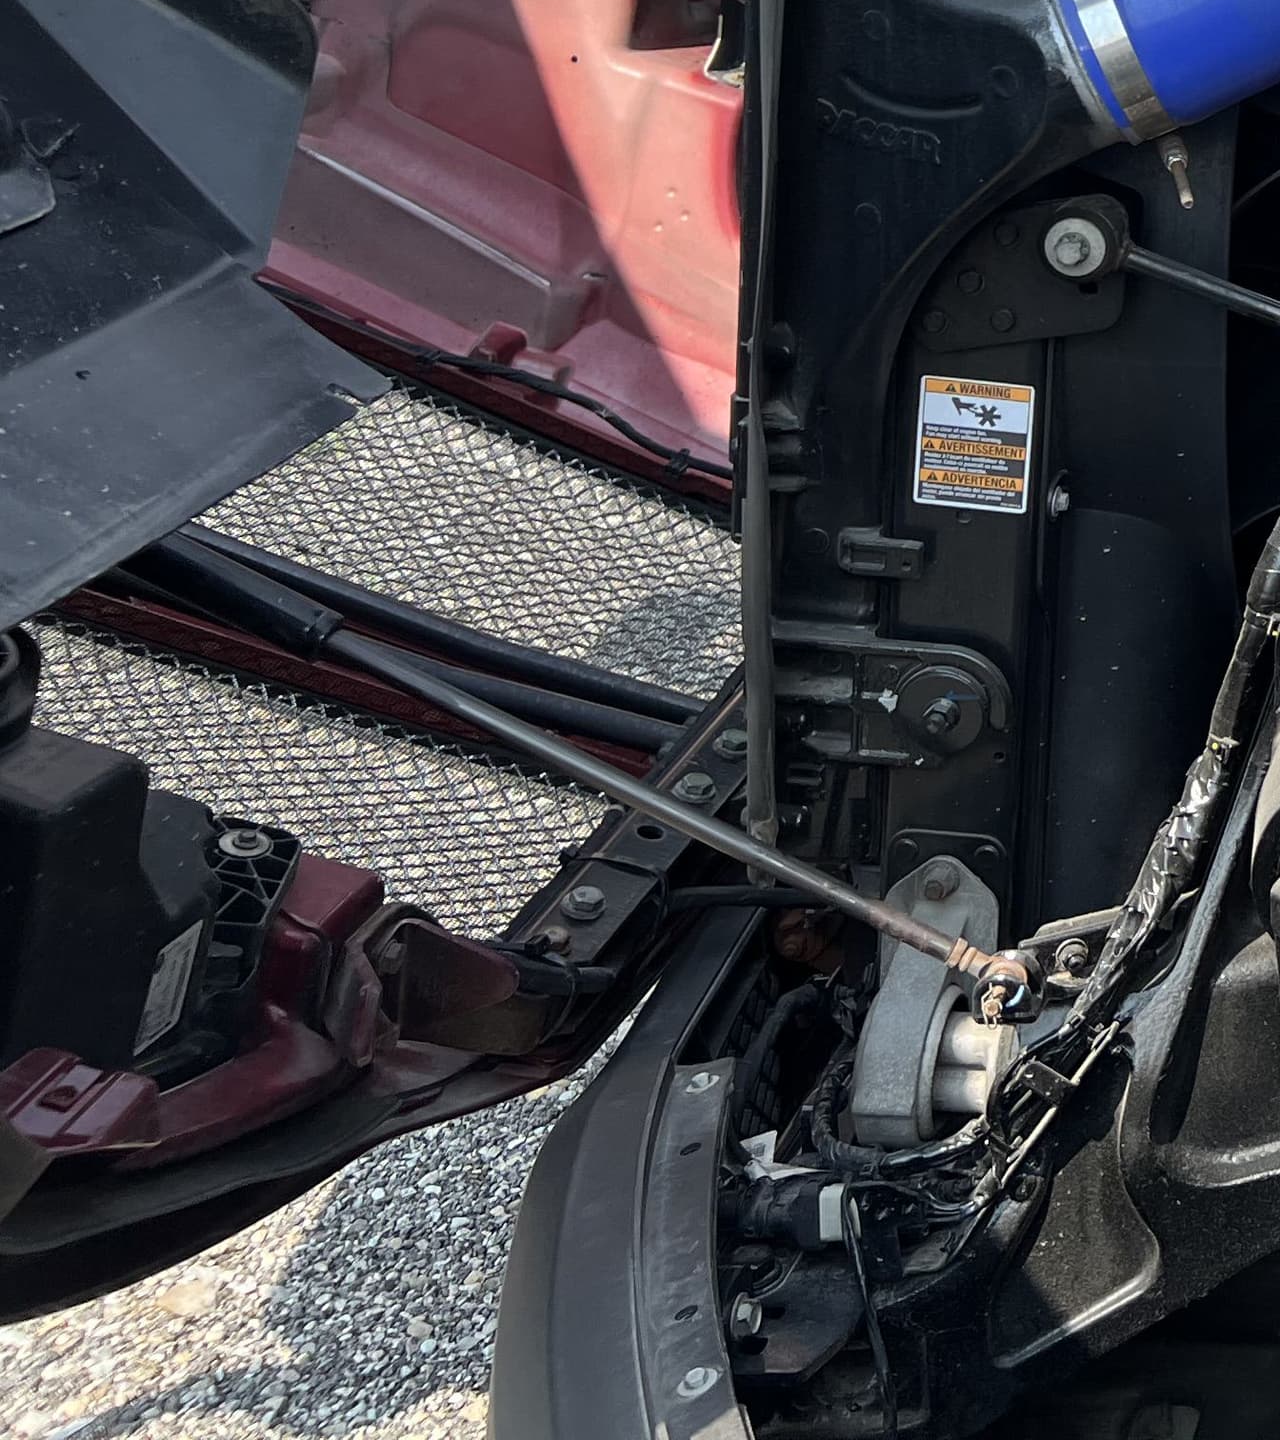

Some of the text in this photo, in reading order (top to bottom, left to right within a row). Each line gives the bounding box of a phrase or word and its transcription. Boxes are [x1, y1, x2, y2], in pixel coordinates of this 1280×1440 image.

[959, 383, 1011, 399] WARNING
[938, 440, 1024, 458] AVERTISSEMENT
[942, 472, 1017, 490] ADVERTENCIA
